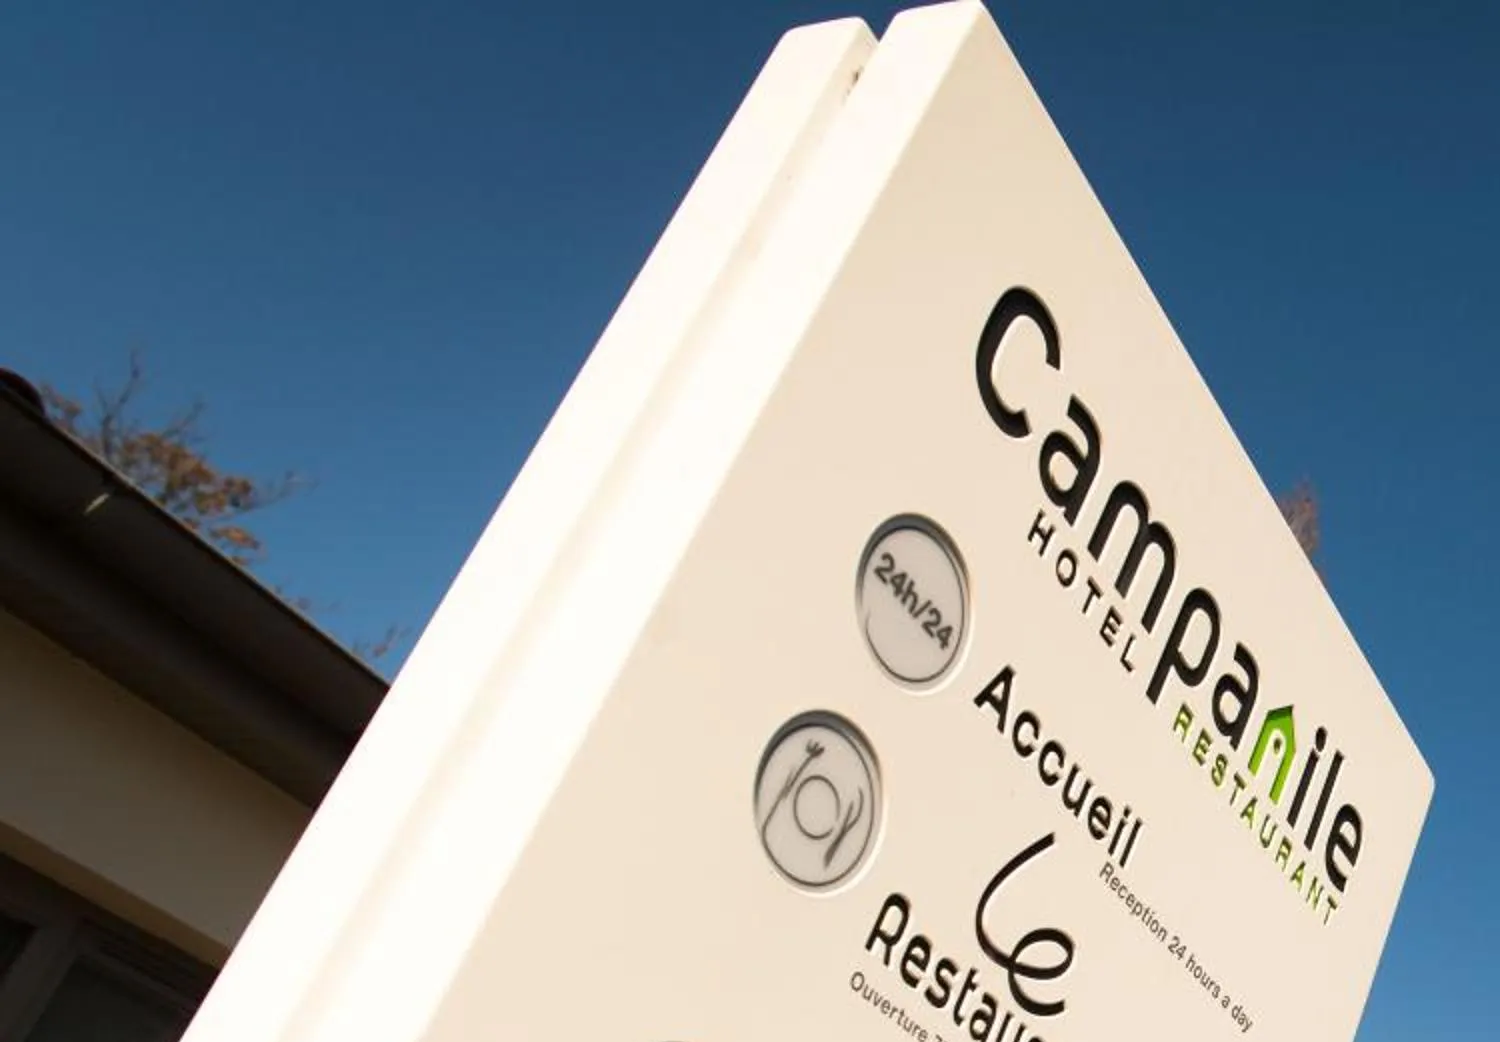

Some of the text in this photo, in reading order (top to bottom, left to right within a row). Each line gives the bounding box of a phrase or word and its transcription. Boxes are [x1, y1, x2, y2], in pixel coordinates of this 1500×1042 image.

[873, 552, 954, 650] 24h/24
[975, 285, 1363, 893] Campanile
[1027, 509, 1138, 672] HOTEL
[974, 663, 1144, 868] Accueil
[1172, 702, 1339, 926] RESTAURANT
[1099, 861, 1254, 1033] Reception 24 hours a day
